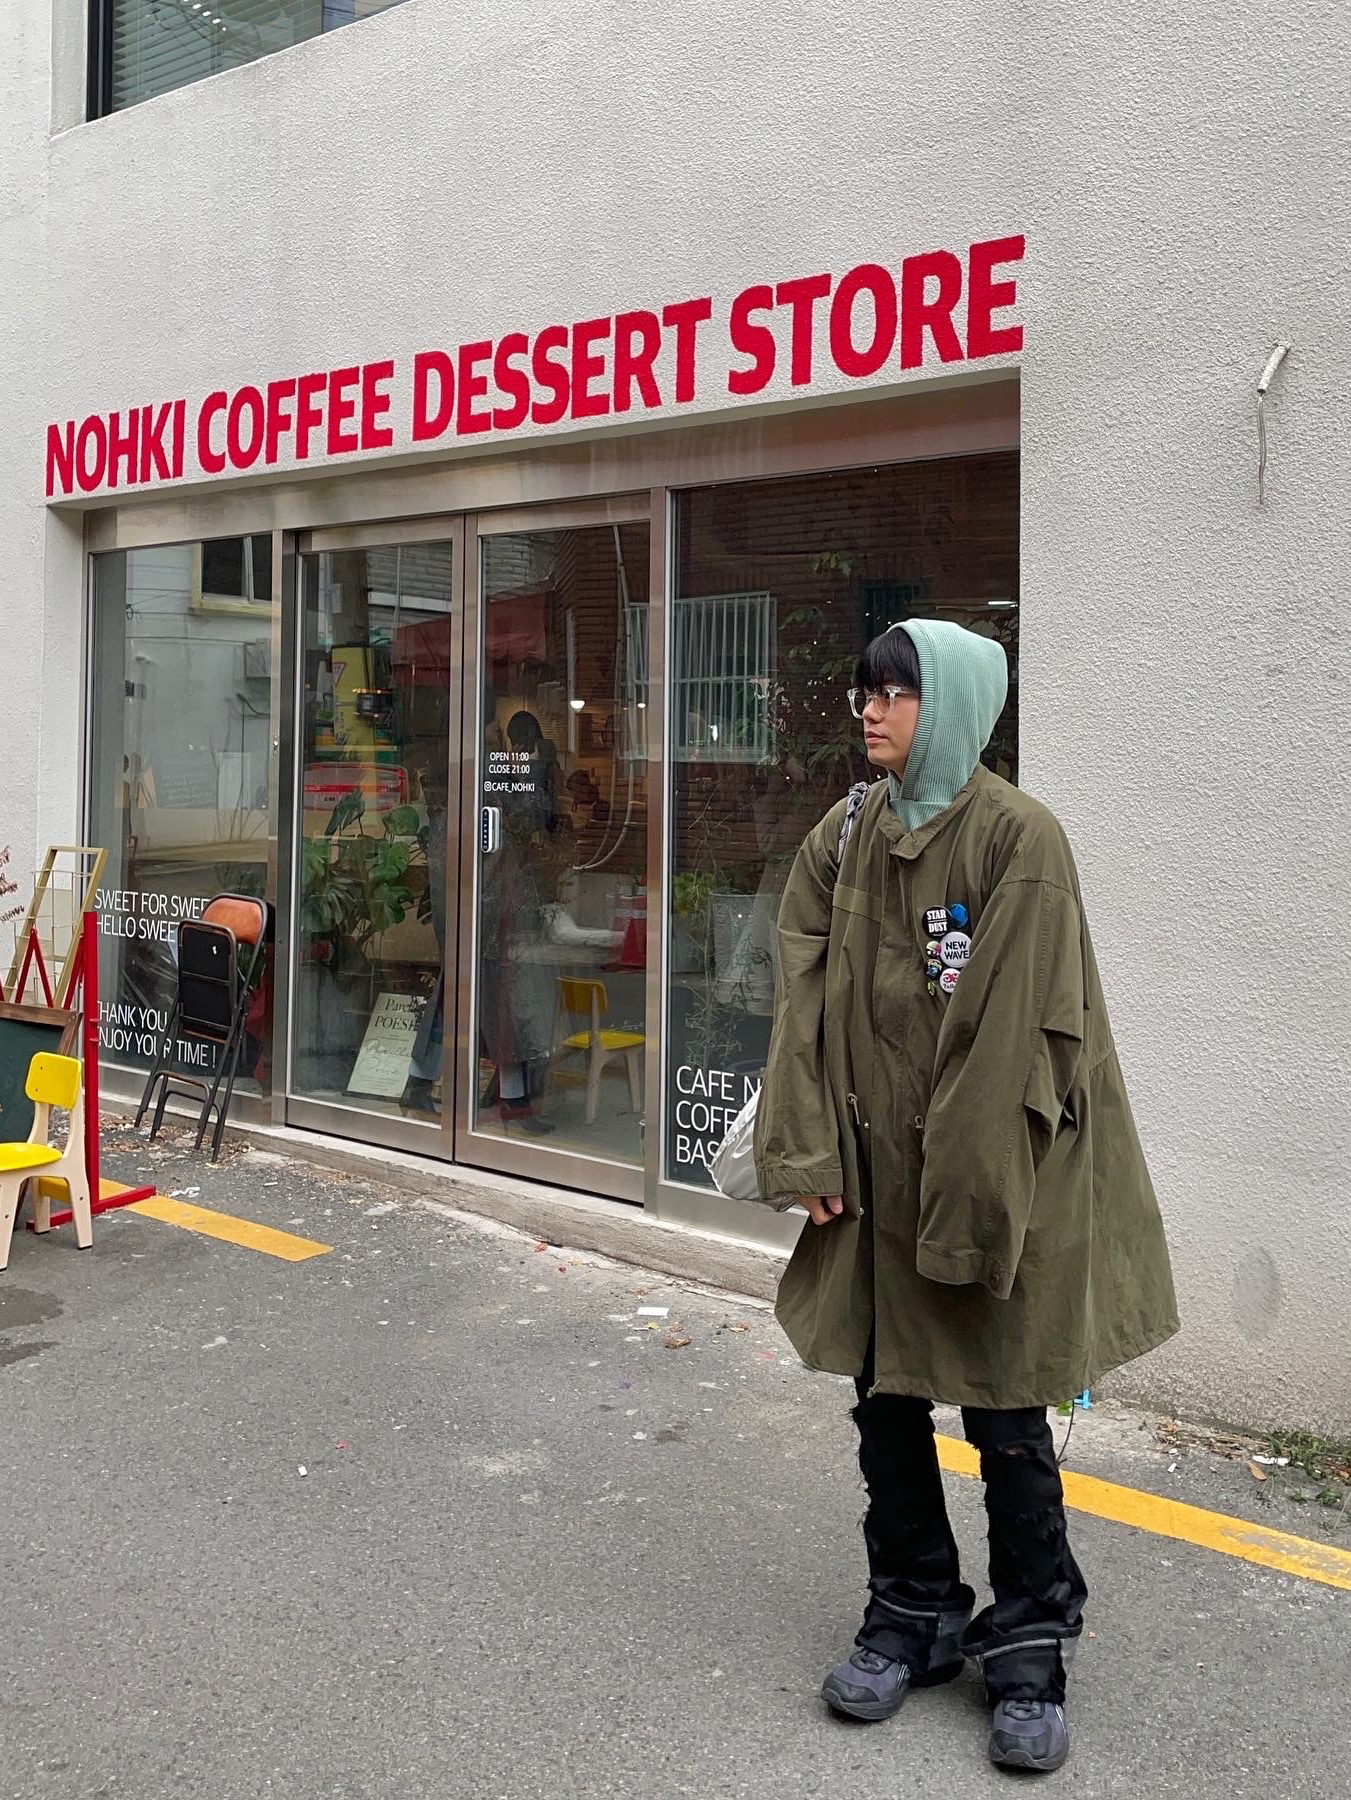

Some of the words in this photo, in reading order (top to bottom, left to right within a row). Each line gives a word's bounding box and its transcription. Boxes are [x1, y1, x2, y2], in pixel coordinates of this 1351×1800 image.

[46, 399, 186, 497] NOHKI
[198, 360, 394, 474] COFFEE
[413, 298, 712, 442] DESSERT
[728, 235, 1026, 395] STORE
[490, 752, 509, 761] OPEN
[511, 752, 530, 761] 11:00
[488, 764, 510, 774] CLOSE
[511, 764, 530, 774] 21:00
[94, 888, 138, 913] SWEET
[141, 892, 168, 916] FOR
[926, 909, 946, 920] STAR
[928, 921, 948, 933] DUST
[945, 940, 967, 950] NEW
[944, 950, 970, 960] WAVE
[138, 1007, 168, 1032] YOU
[97, 1025, 133, 1052] NJOY
[176, 1039, 209, 1067] TIME
[676, 1065, 735, 1102] CAFE
